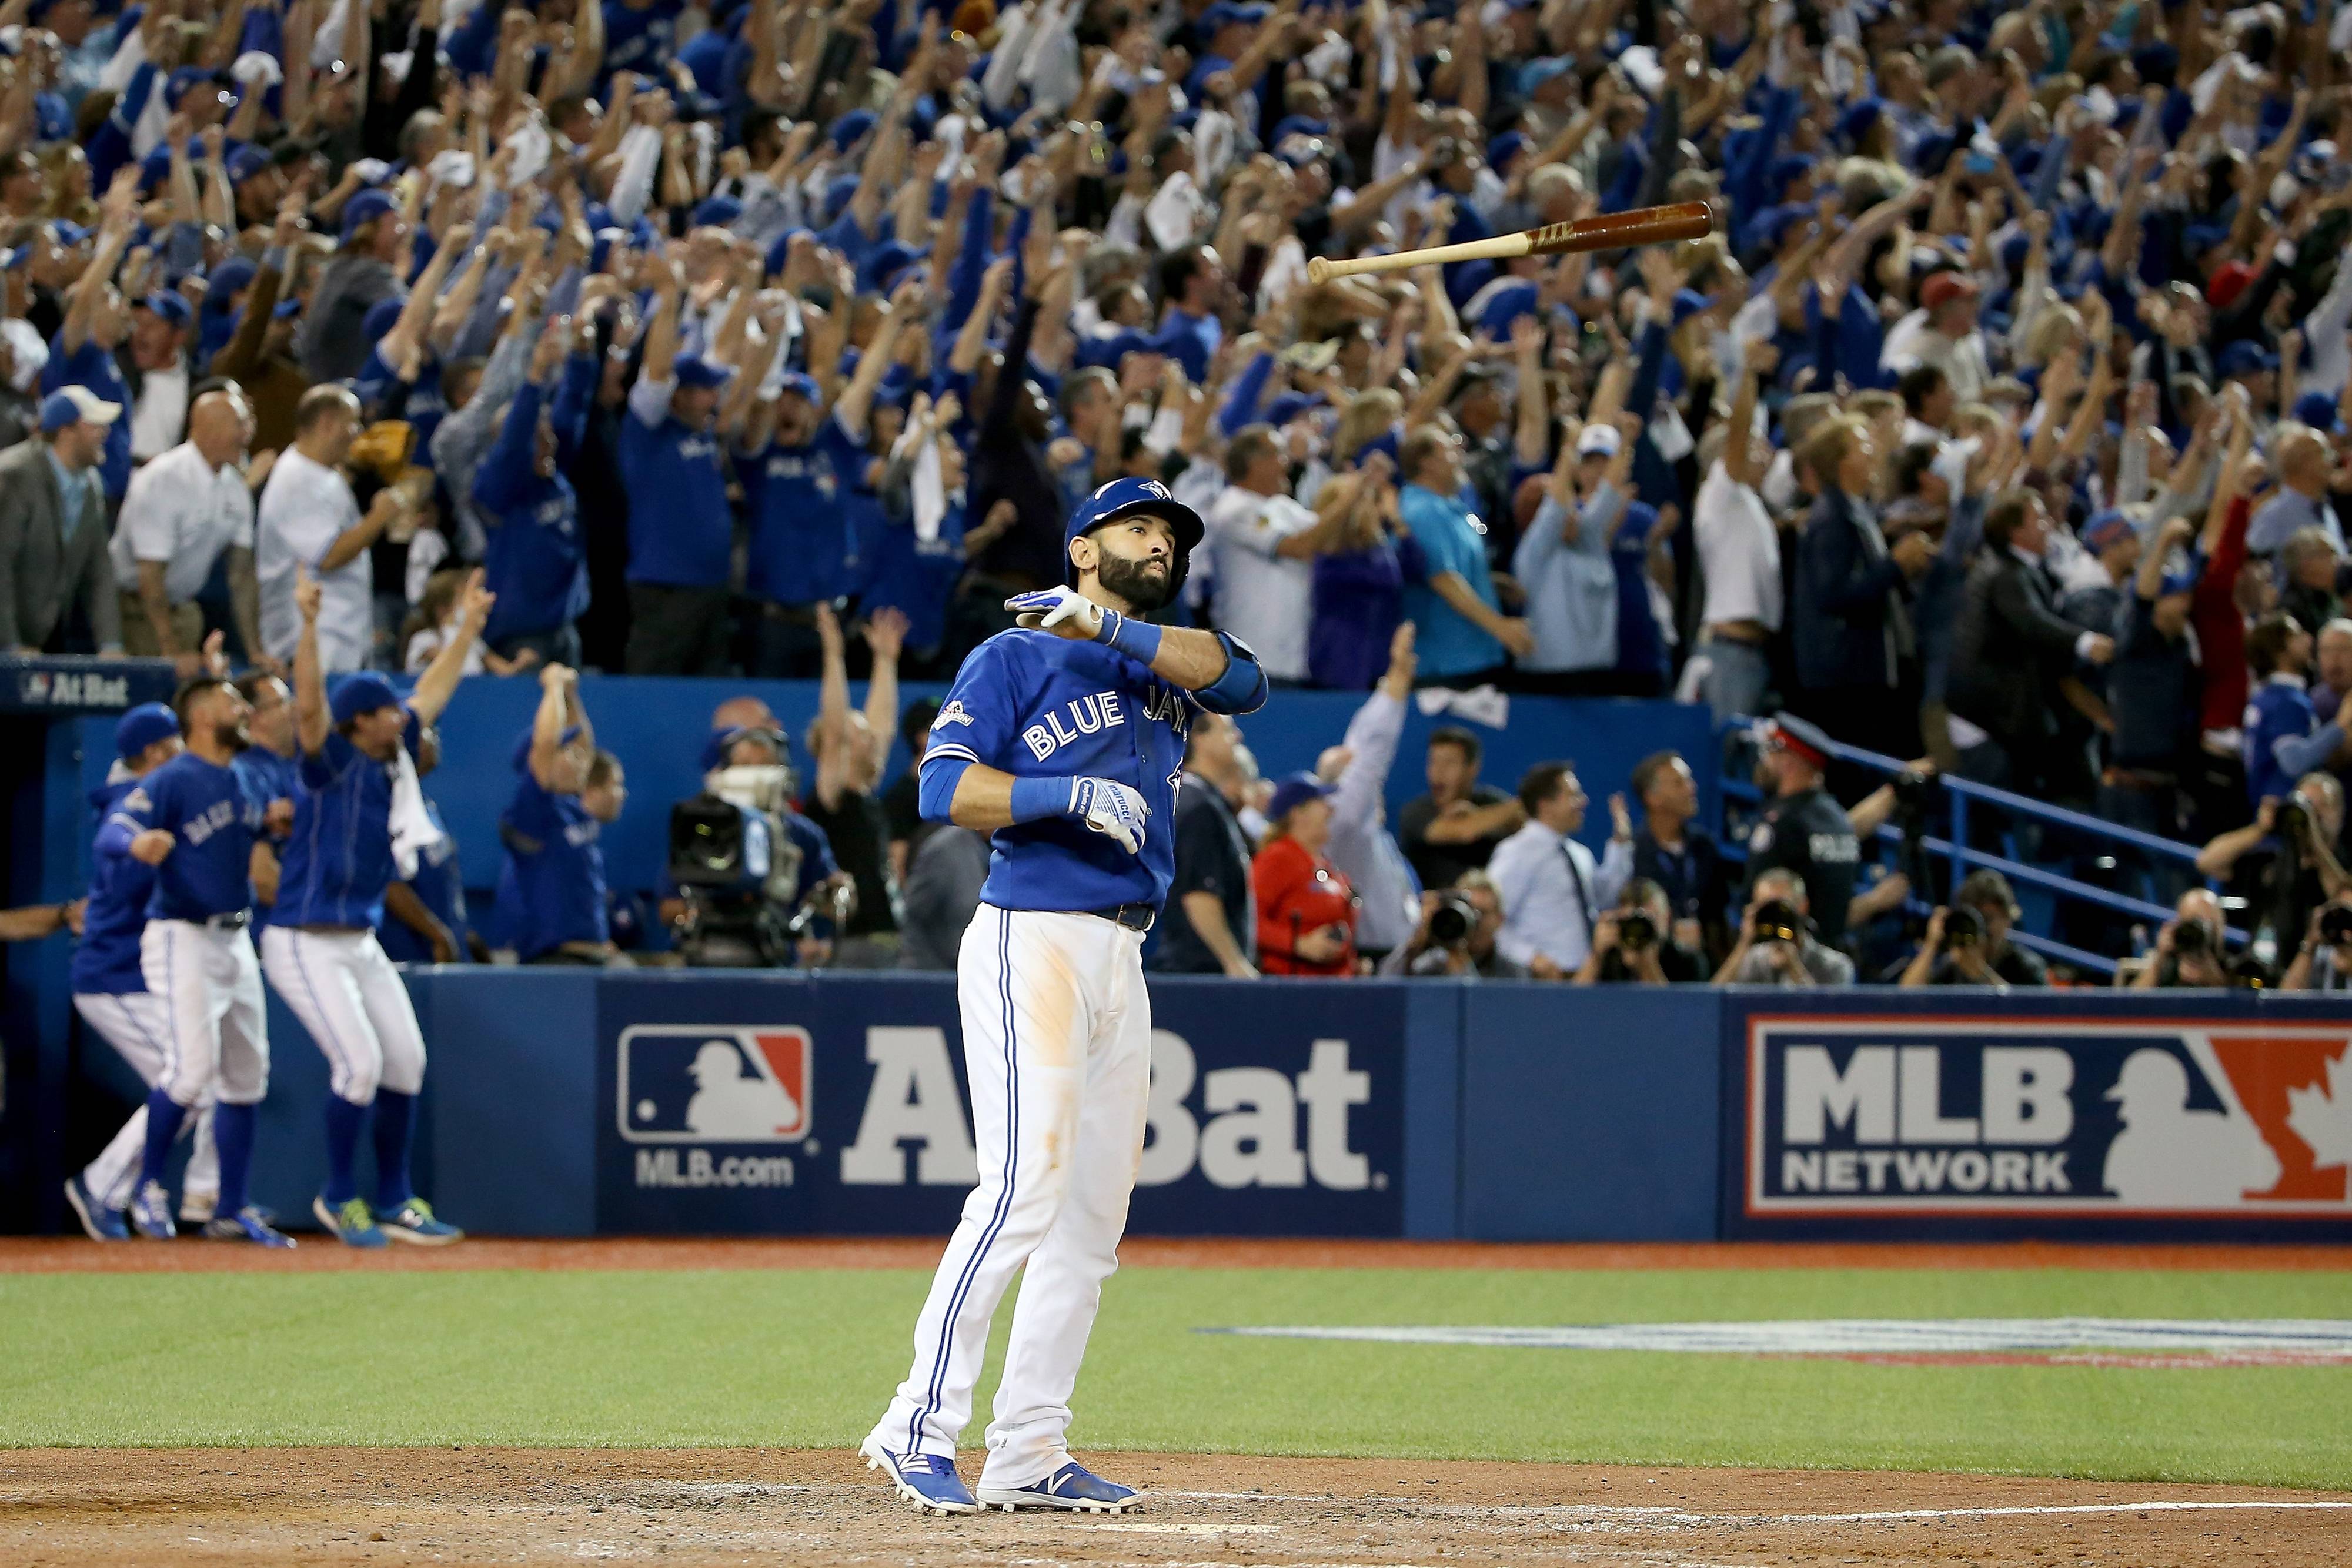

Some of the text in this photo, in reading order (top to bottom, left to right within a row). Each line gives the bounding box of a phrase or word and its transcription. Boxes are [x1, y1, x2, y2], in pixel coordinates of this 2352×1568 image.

[51, 671, 128, 707] At Bat
[1022, 690, 1125, 763] BLUE
[1108, 784, 1131, 820] marucci
[840, 1025, 980, 1185] A
[1783, 1045, 2074, 1144] MLB
[636, 1149, 794, 1187] MLB.com
[1782, 1151, 2070, 1191] NETWORK
